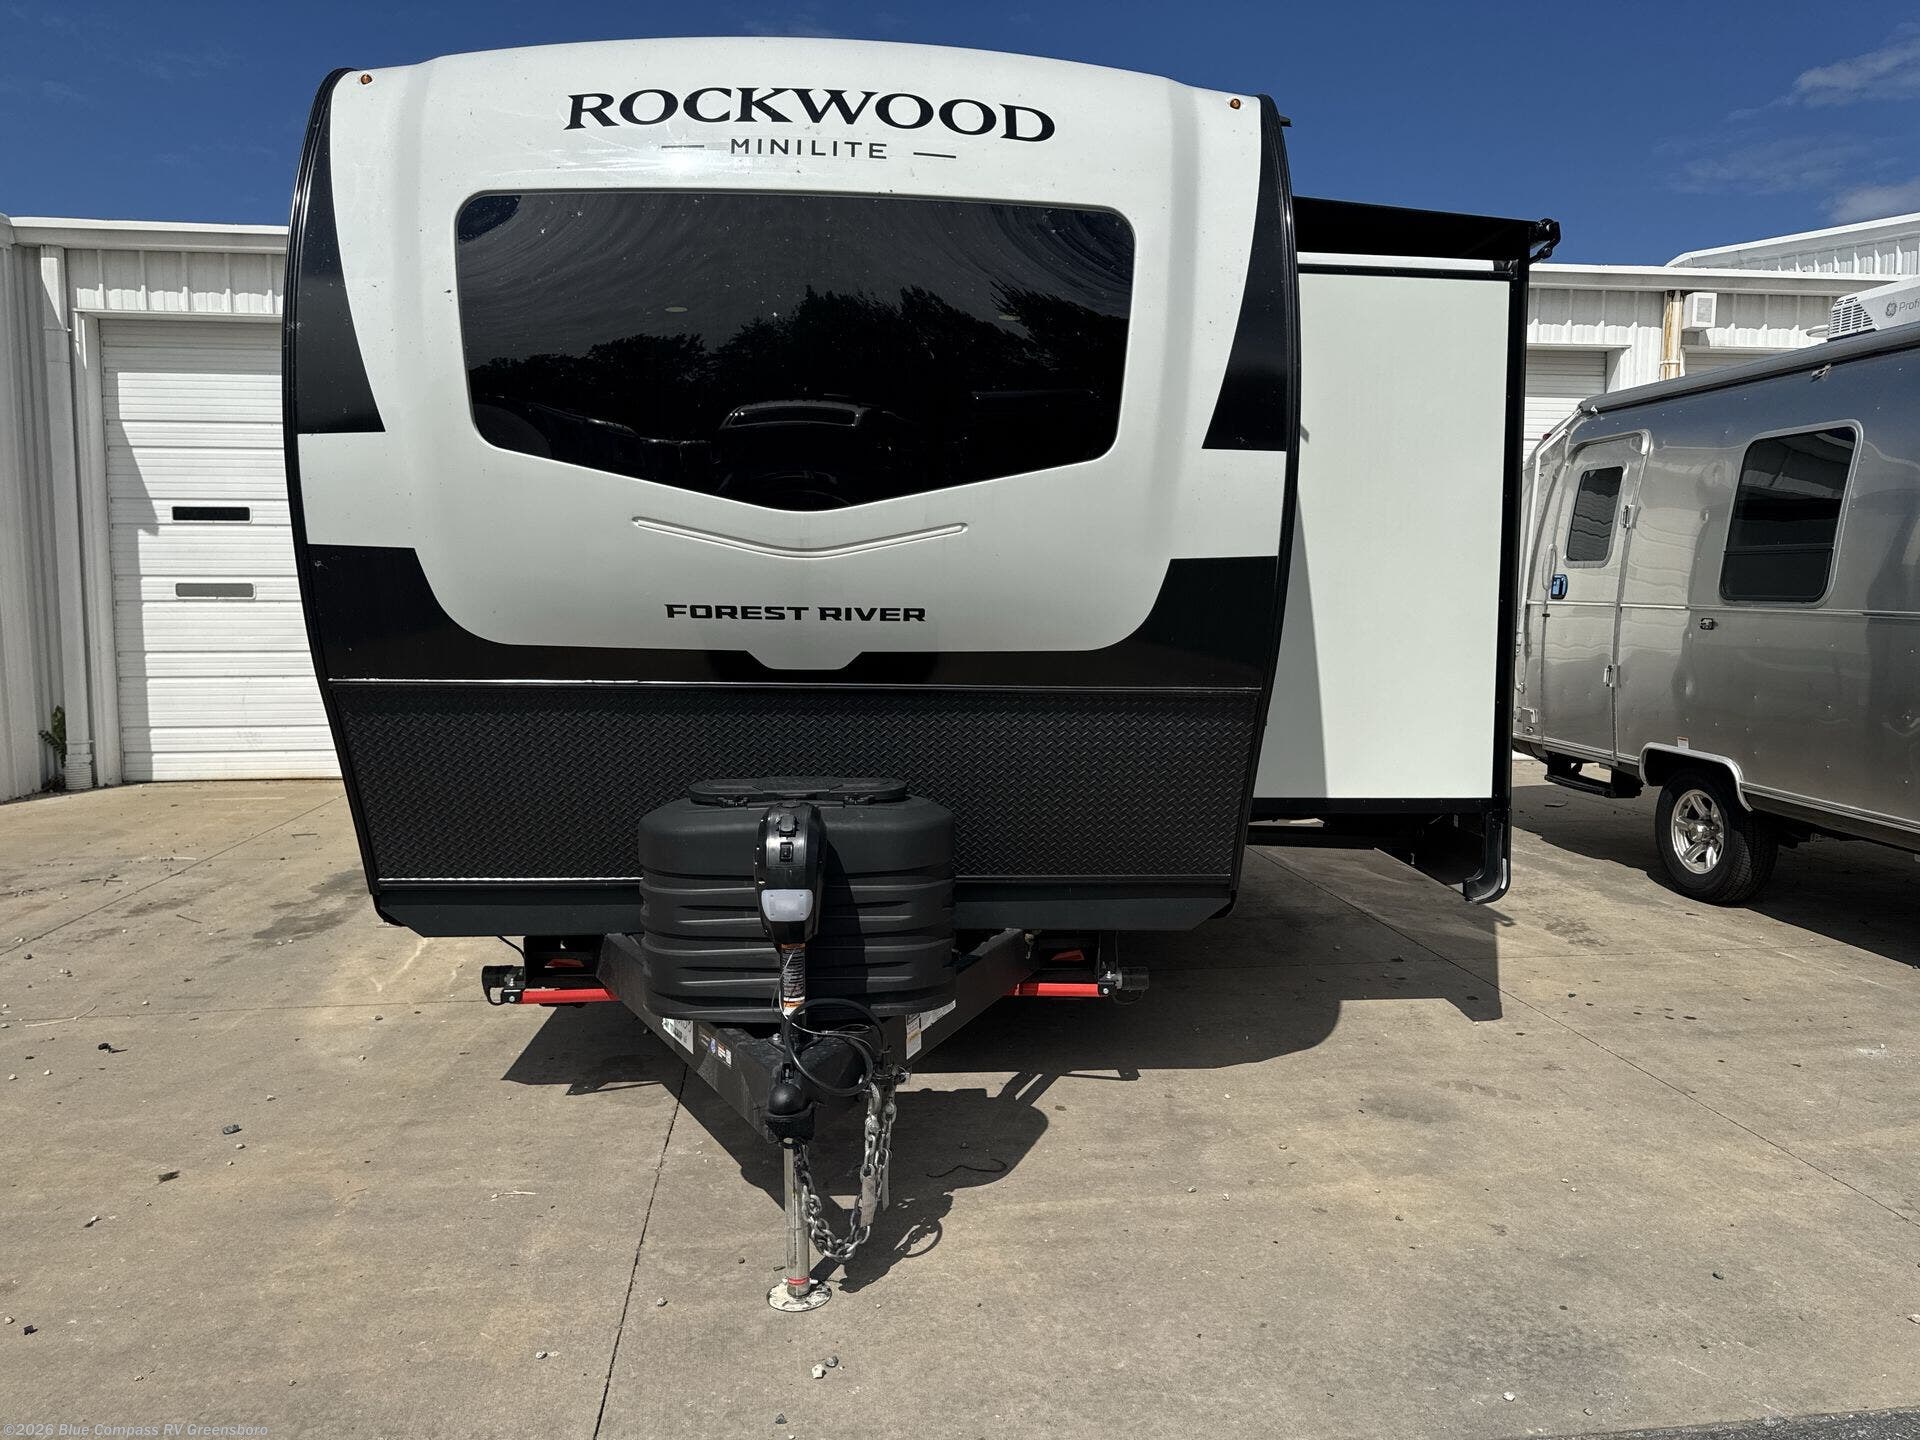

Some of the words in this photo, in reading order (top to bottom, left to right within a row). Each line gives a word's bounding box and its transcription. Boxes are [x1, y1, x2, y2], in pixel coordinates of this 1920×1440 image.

[563, 87, 1056, 143] ROCKWOOD
[730, 138, 888, 160] MINILITE
[664, 603, 809, 621] FOREST
[817, 606, 926, 622] RIVER
